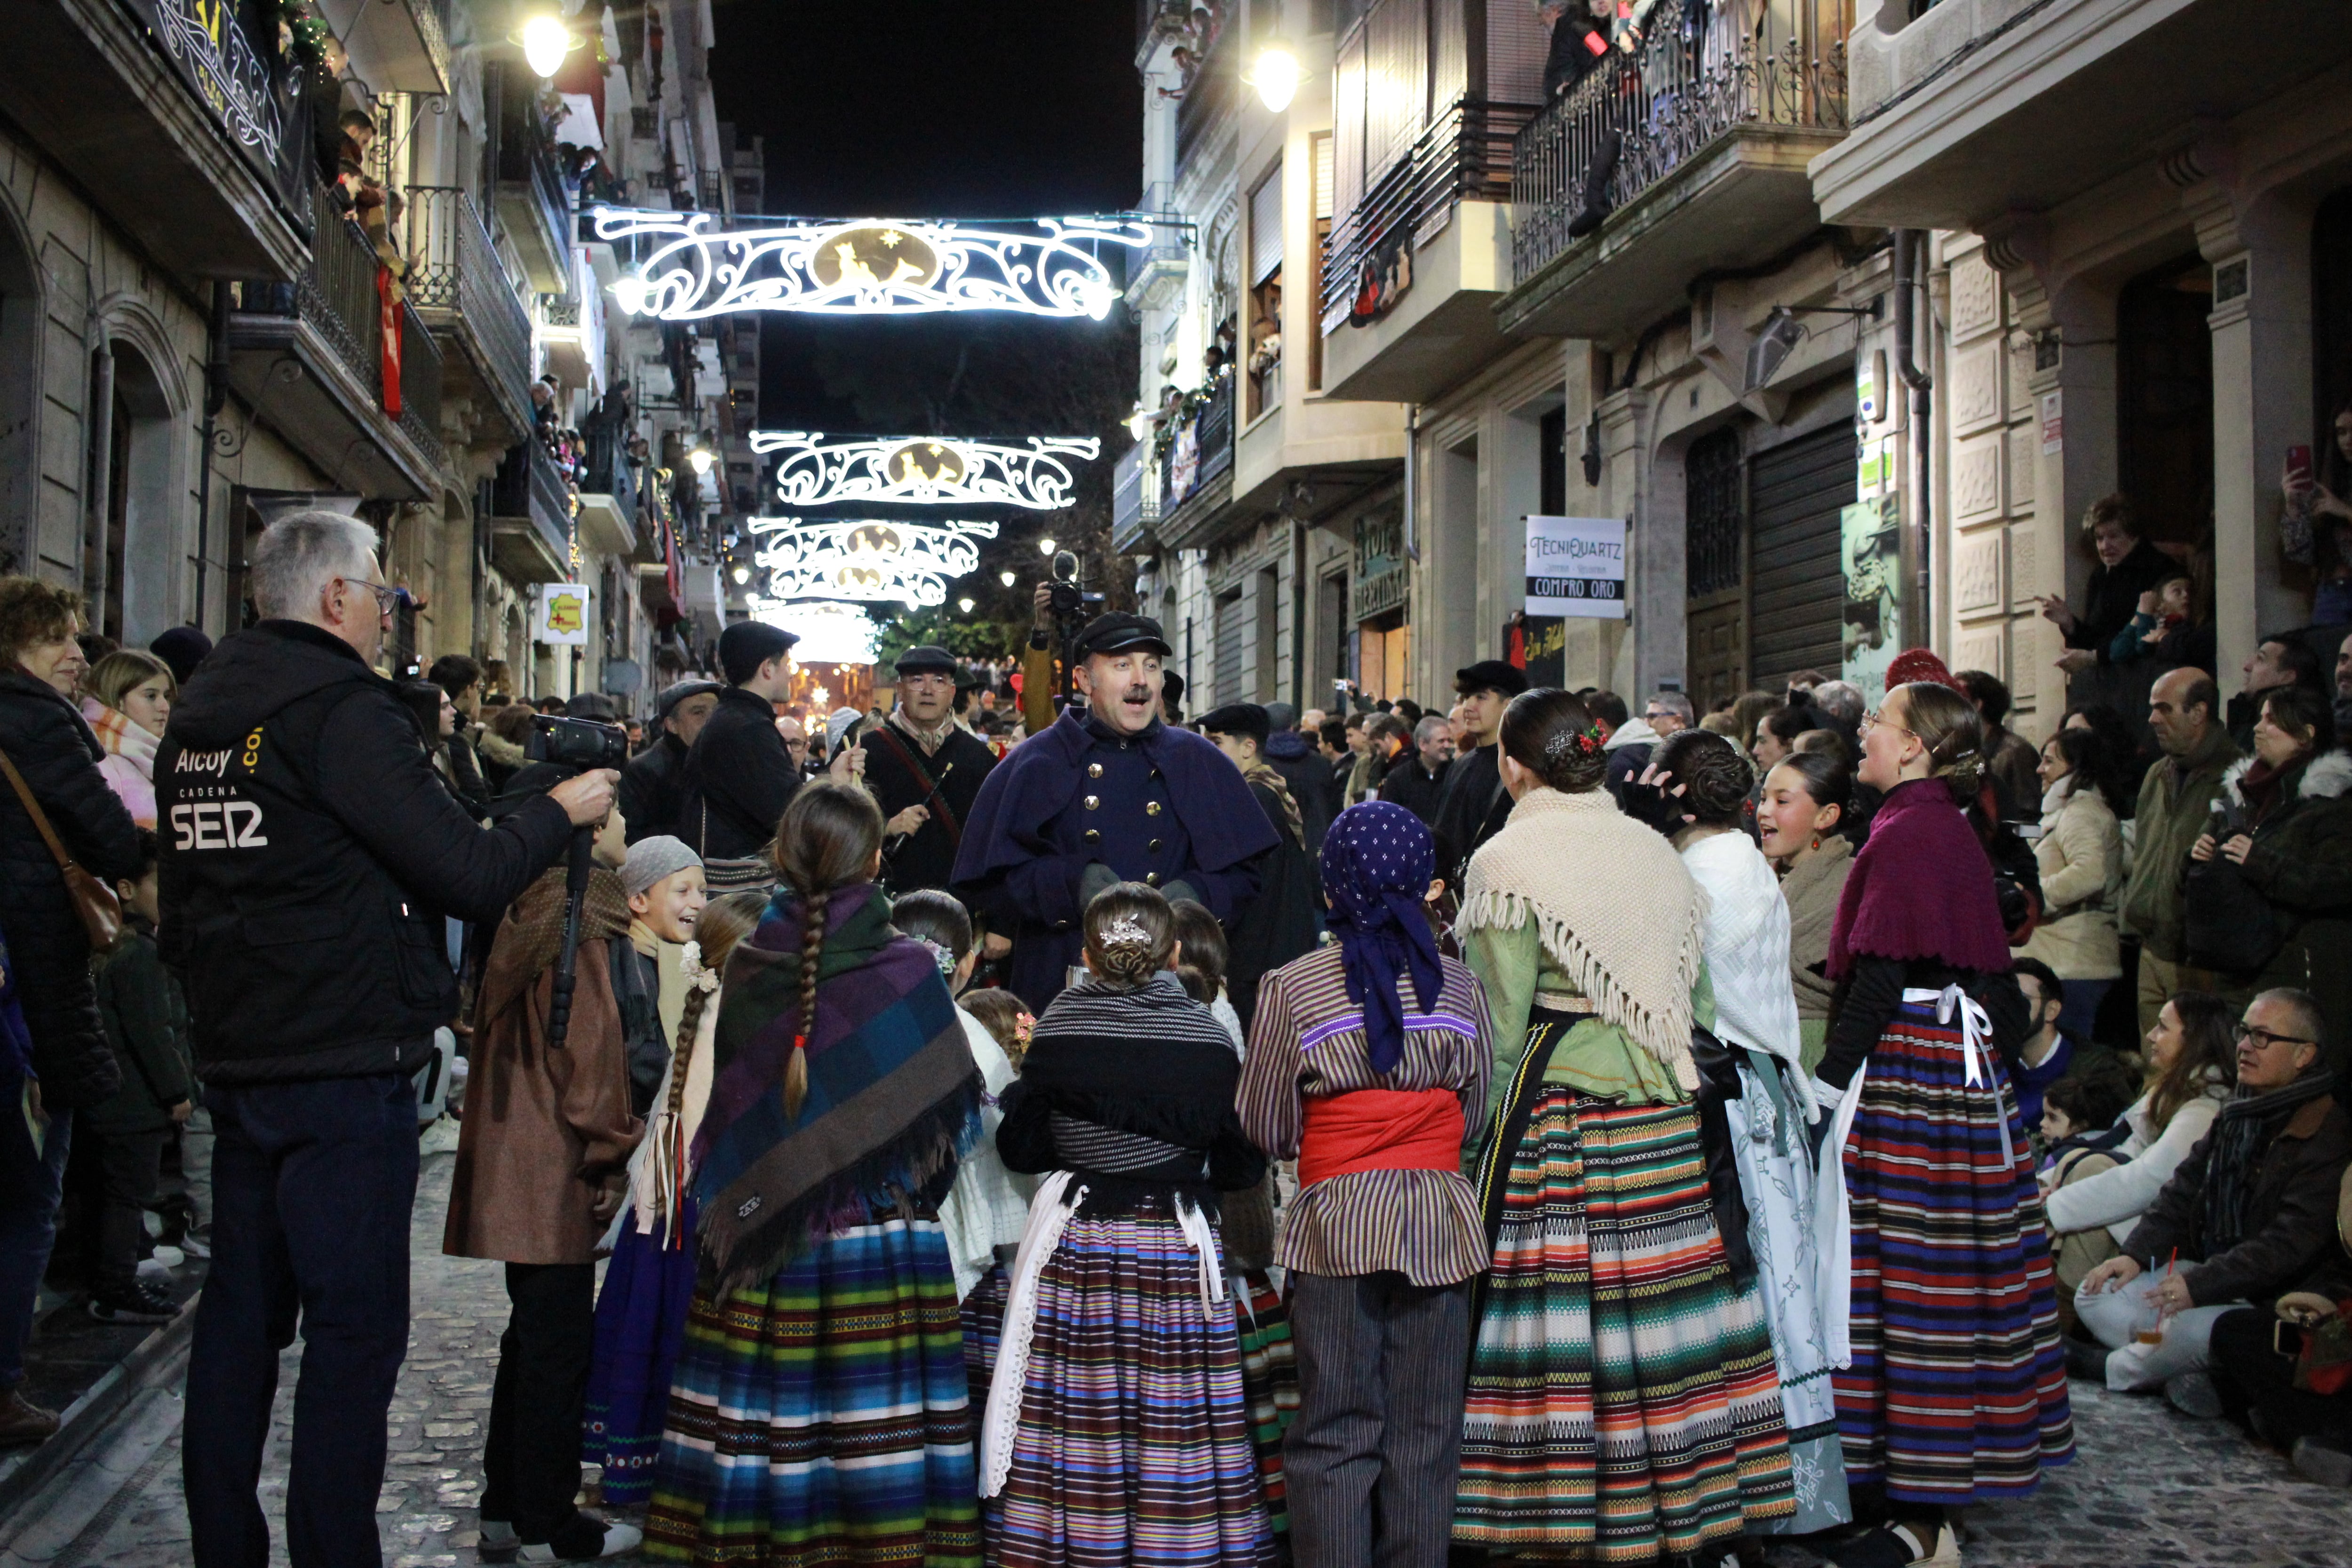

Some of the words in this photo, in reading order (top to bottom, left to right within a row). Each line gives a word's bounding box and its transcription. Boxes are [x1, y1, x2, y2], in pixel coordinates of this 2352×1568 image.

[1535, 579, 1584, 596] COMPRO
[1591, 581, 1615, 598] ORO
[175, 748, 232, 778] Alcoy
[180, 786, 237, 798] CADENA
[171, 801, 268, 851] SER
